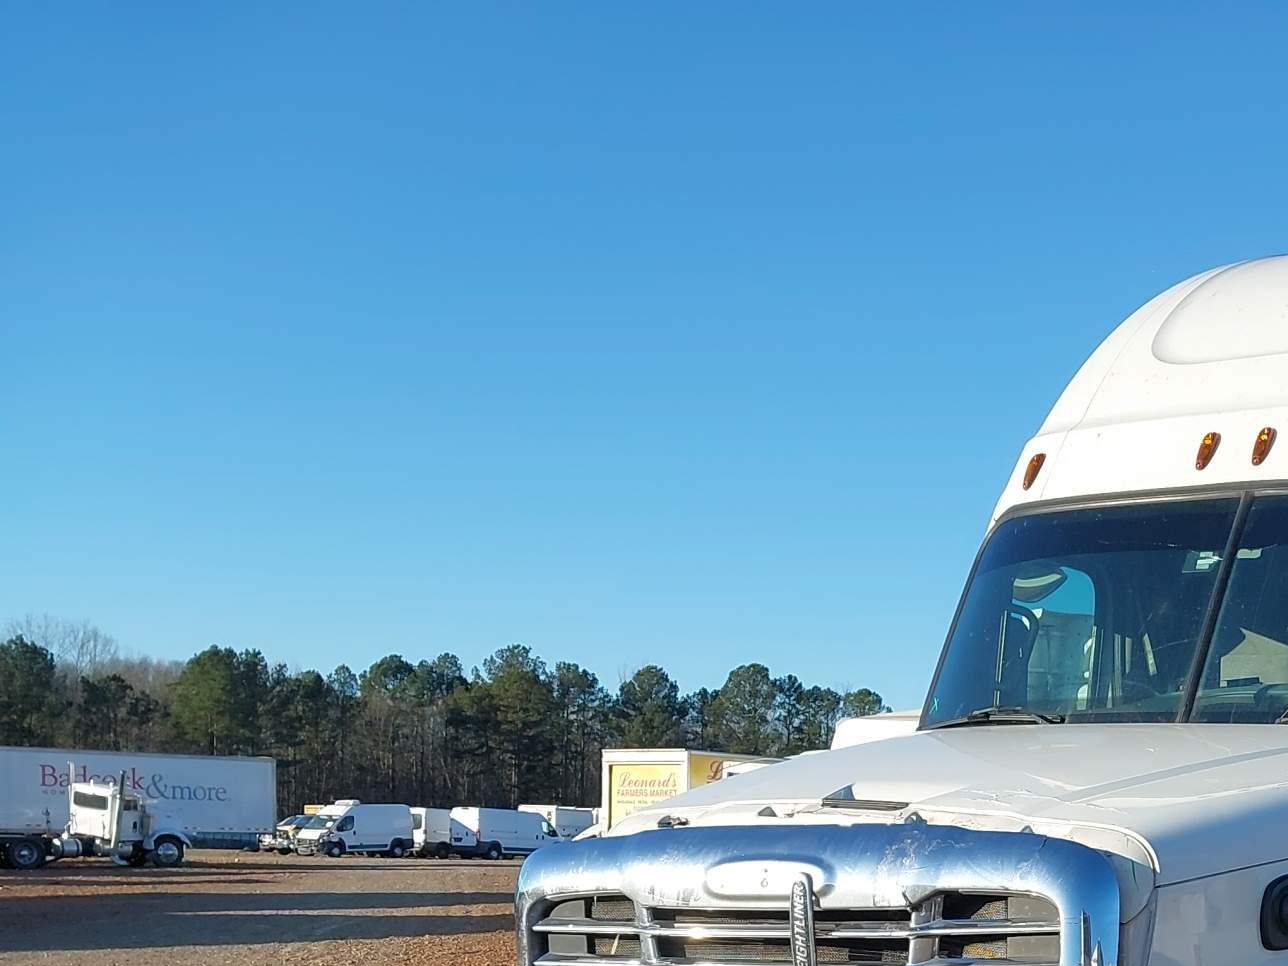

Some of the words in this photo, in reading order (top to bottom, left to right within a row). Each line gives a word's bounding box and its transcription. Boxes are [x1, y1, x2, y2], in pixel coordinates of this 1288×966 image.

[40, 764, 144, 790] Badcok
[618, 771, 677, 788] Leonard's
[617, 789, 648, 798] FARMERS
[650, 789, 678, 798] MARKET
